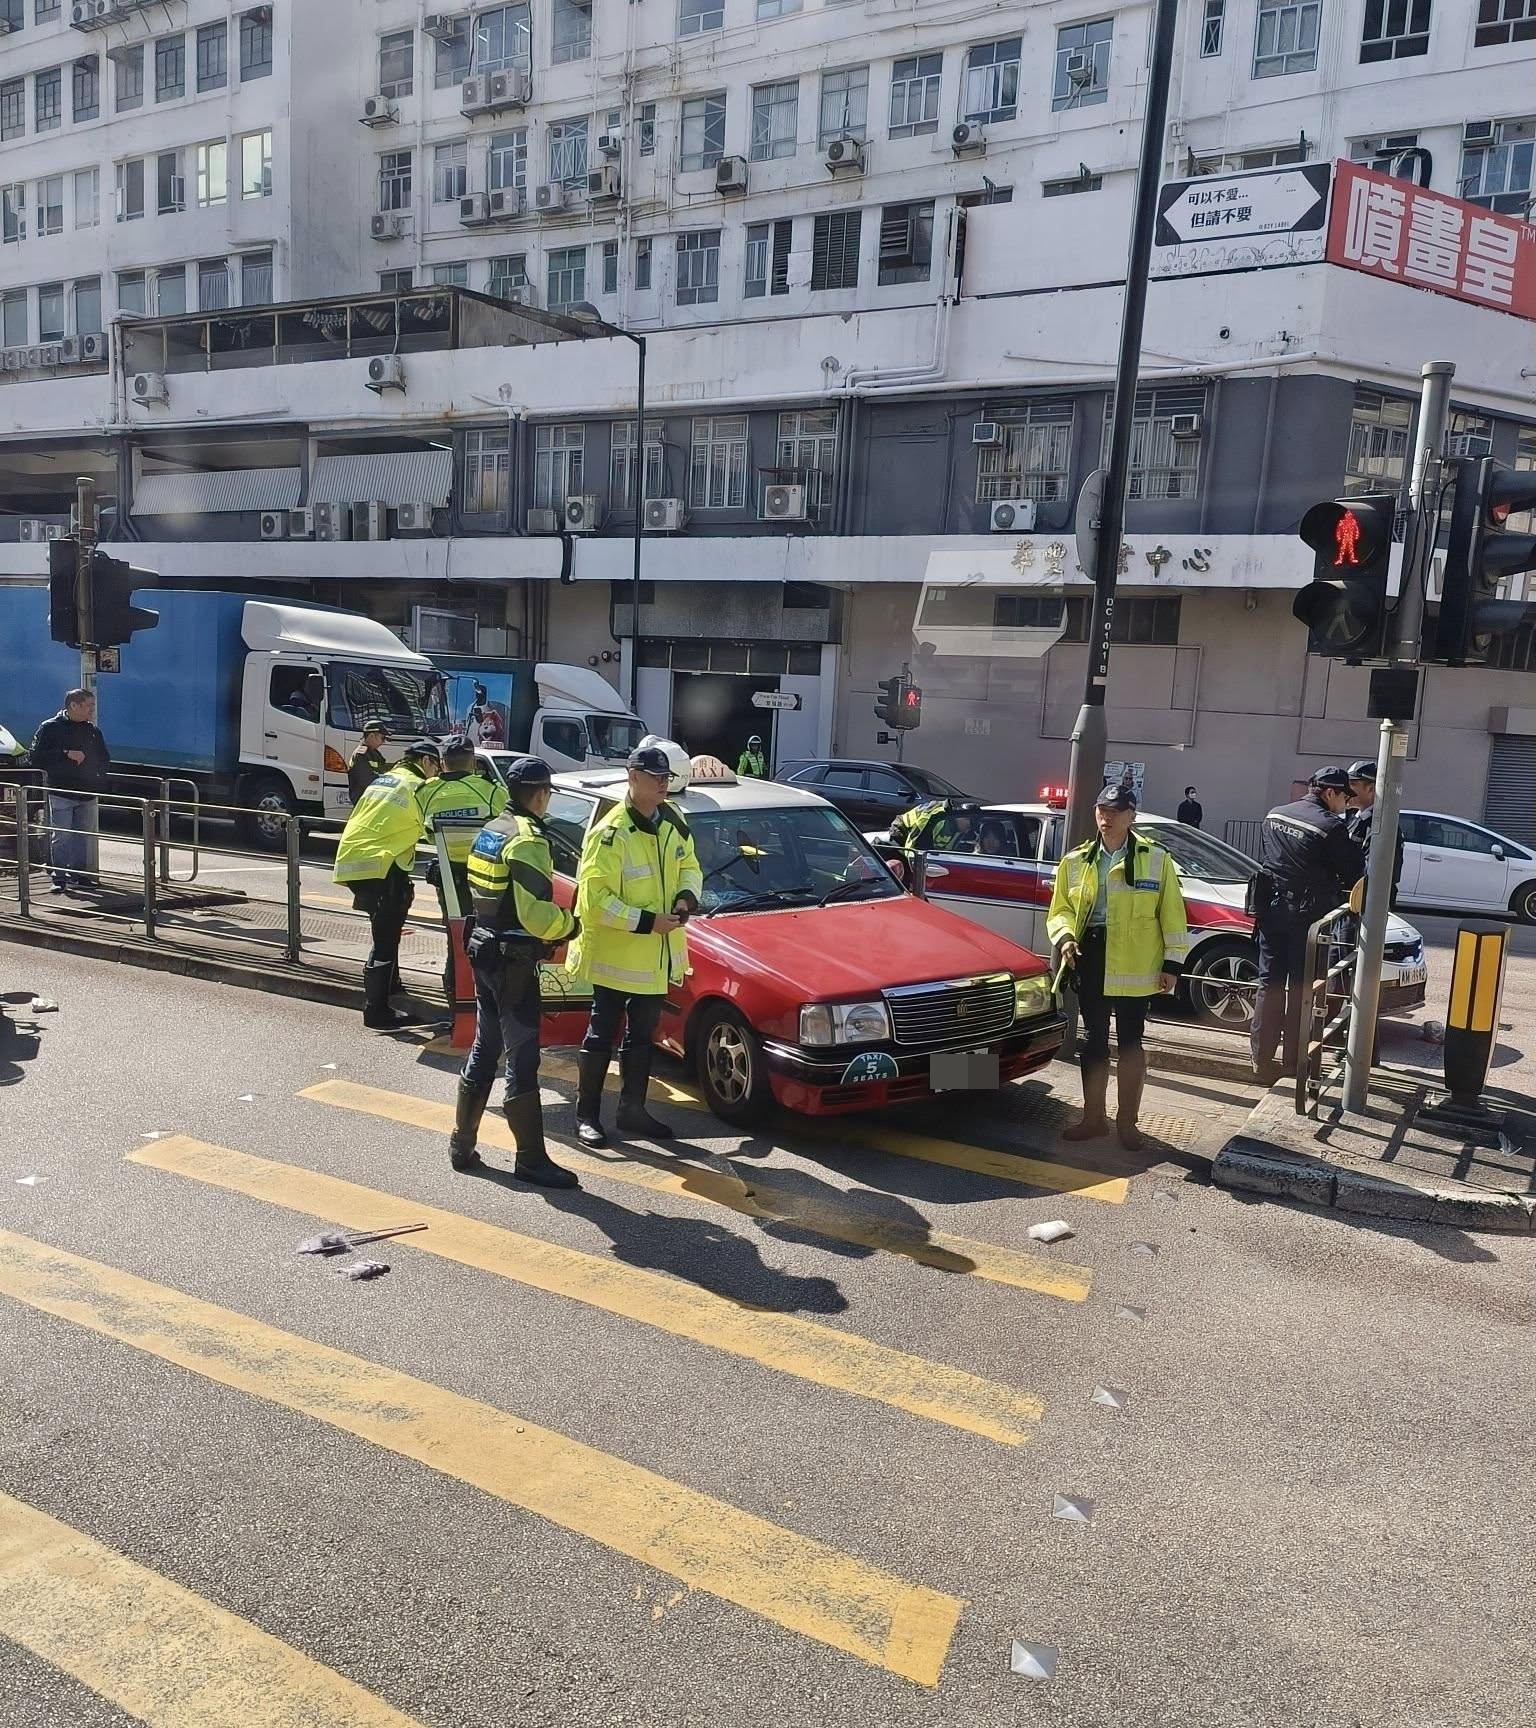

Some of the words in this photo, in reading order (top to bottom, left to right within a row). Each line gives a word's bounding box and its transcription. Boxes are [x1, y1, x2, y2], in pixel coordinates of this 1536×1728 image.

[1191, 206, 1252, 229] 但請不要
[1344, 176, 1518, 305] 噴畫皇
[692, 767, 724, 778] TAXI
[440, 809, 468, 818] POLICE
[1272, 821, 1301, 838] POLICE
[861, 1054, 882, 1062] TAXI
[866, 1061, 877, 1074] 5
[853, 1072, 888, 1082] SEATS
